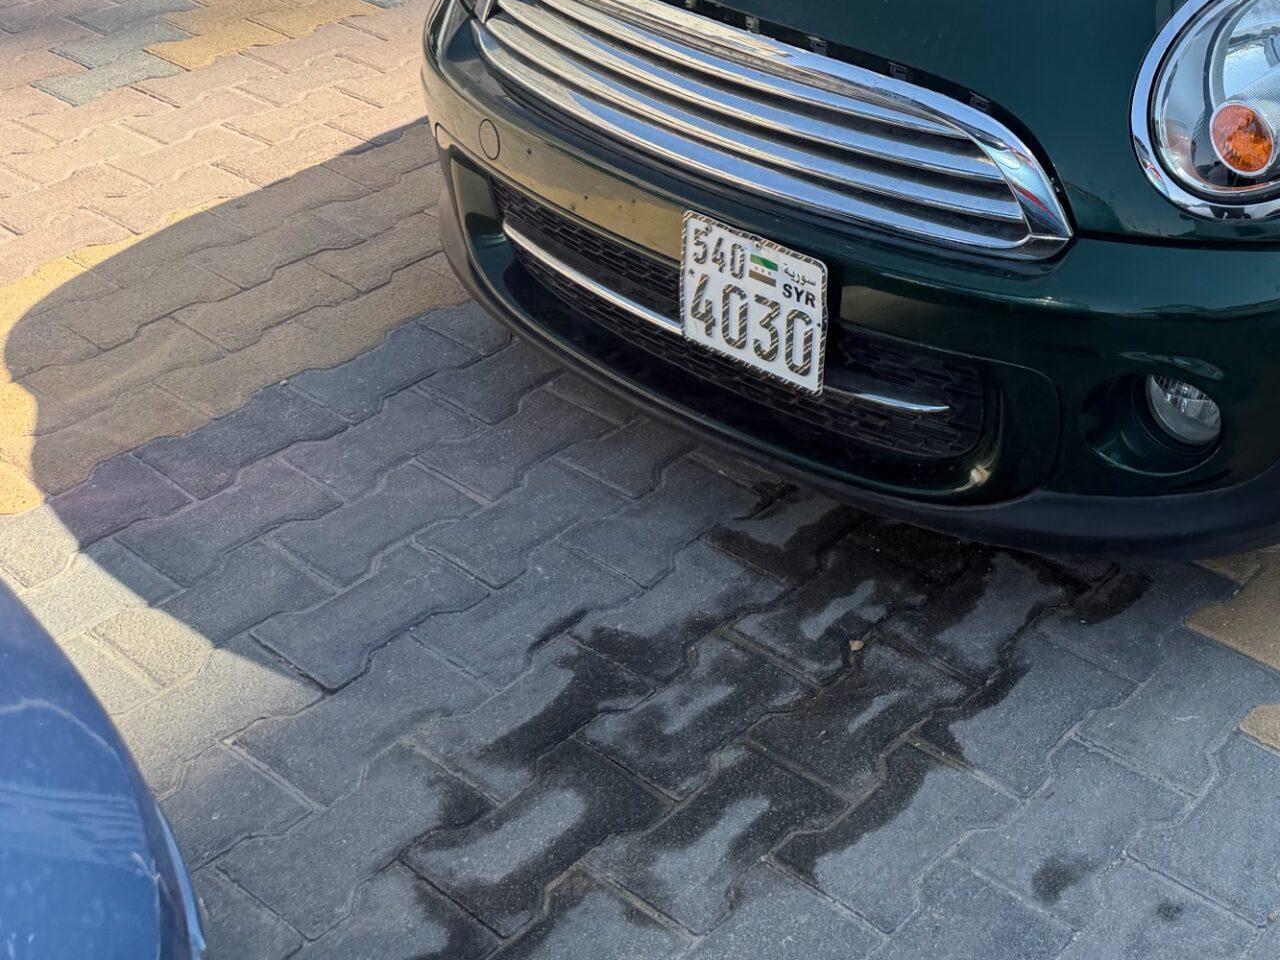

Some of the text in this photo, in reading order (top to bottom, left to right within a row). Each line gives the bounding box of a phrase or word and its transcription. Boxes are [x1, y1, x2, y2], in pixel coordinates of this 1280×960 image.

[693, 227, 745, 280] 540
[782, 283, 817, 309] SYR
[690, 273, 814, 377] 4030
